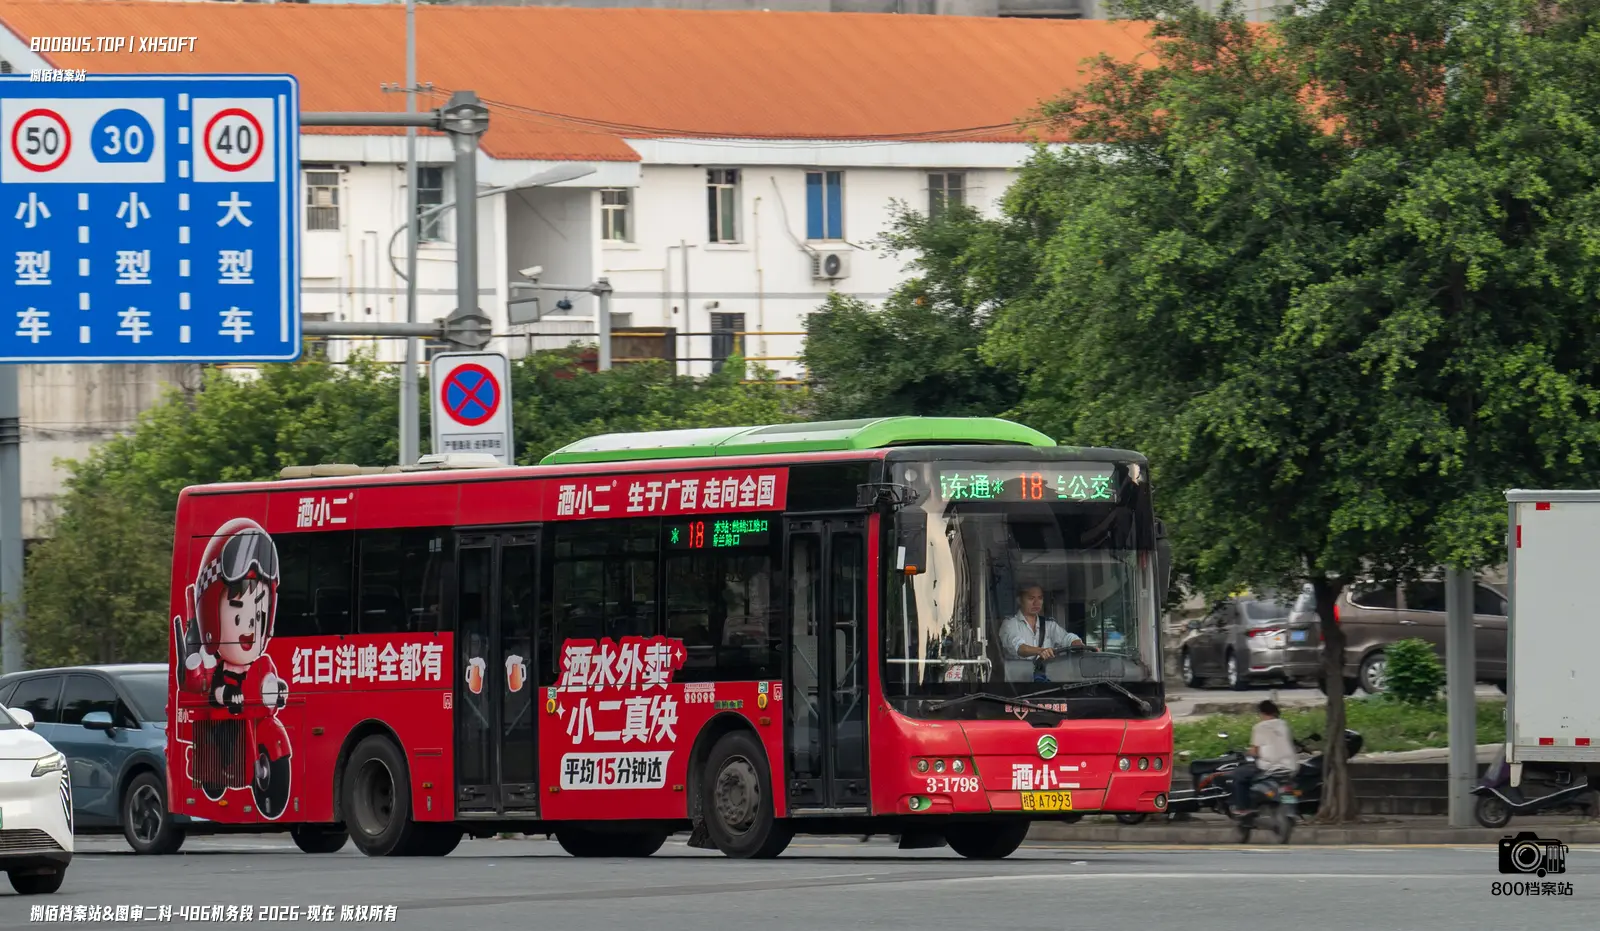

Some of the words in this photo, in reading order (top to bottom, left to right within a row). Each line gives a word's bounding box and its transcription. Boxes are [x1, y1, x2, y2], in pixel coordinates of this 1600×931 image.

[25, 127, 59, 155] 50
[102, 126, 145, 155] 30
[216, 125, 252, 155] 40
[15, 193, 52, 344] 小型车
[115, 192, 153, 344] 小型车
[216, 191, 255, 344] 大型车
[557, 485, 611, 516] 酒小二
[626, 479, 699, 512] 生于广西
[702, 475, 776, 509] 走向全国
[1020, 472, 1043, 500] 18
[297, 497, 347, 527] 酒小二
[688, 521, 704, 548] 18
[291, 642, 443, 684] 红白洋啤全都有
[557, 643, 672, 692] 酒水外卖
[566, 695, 678, 744] 小二真快
[565, 757, 662, 785] 平均15分钟达
[926, 777, 979, 793] 3-1798
[1012, 763, 1080, 790] 酒小二
